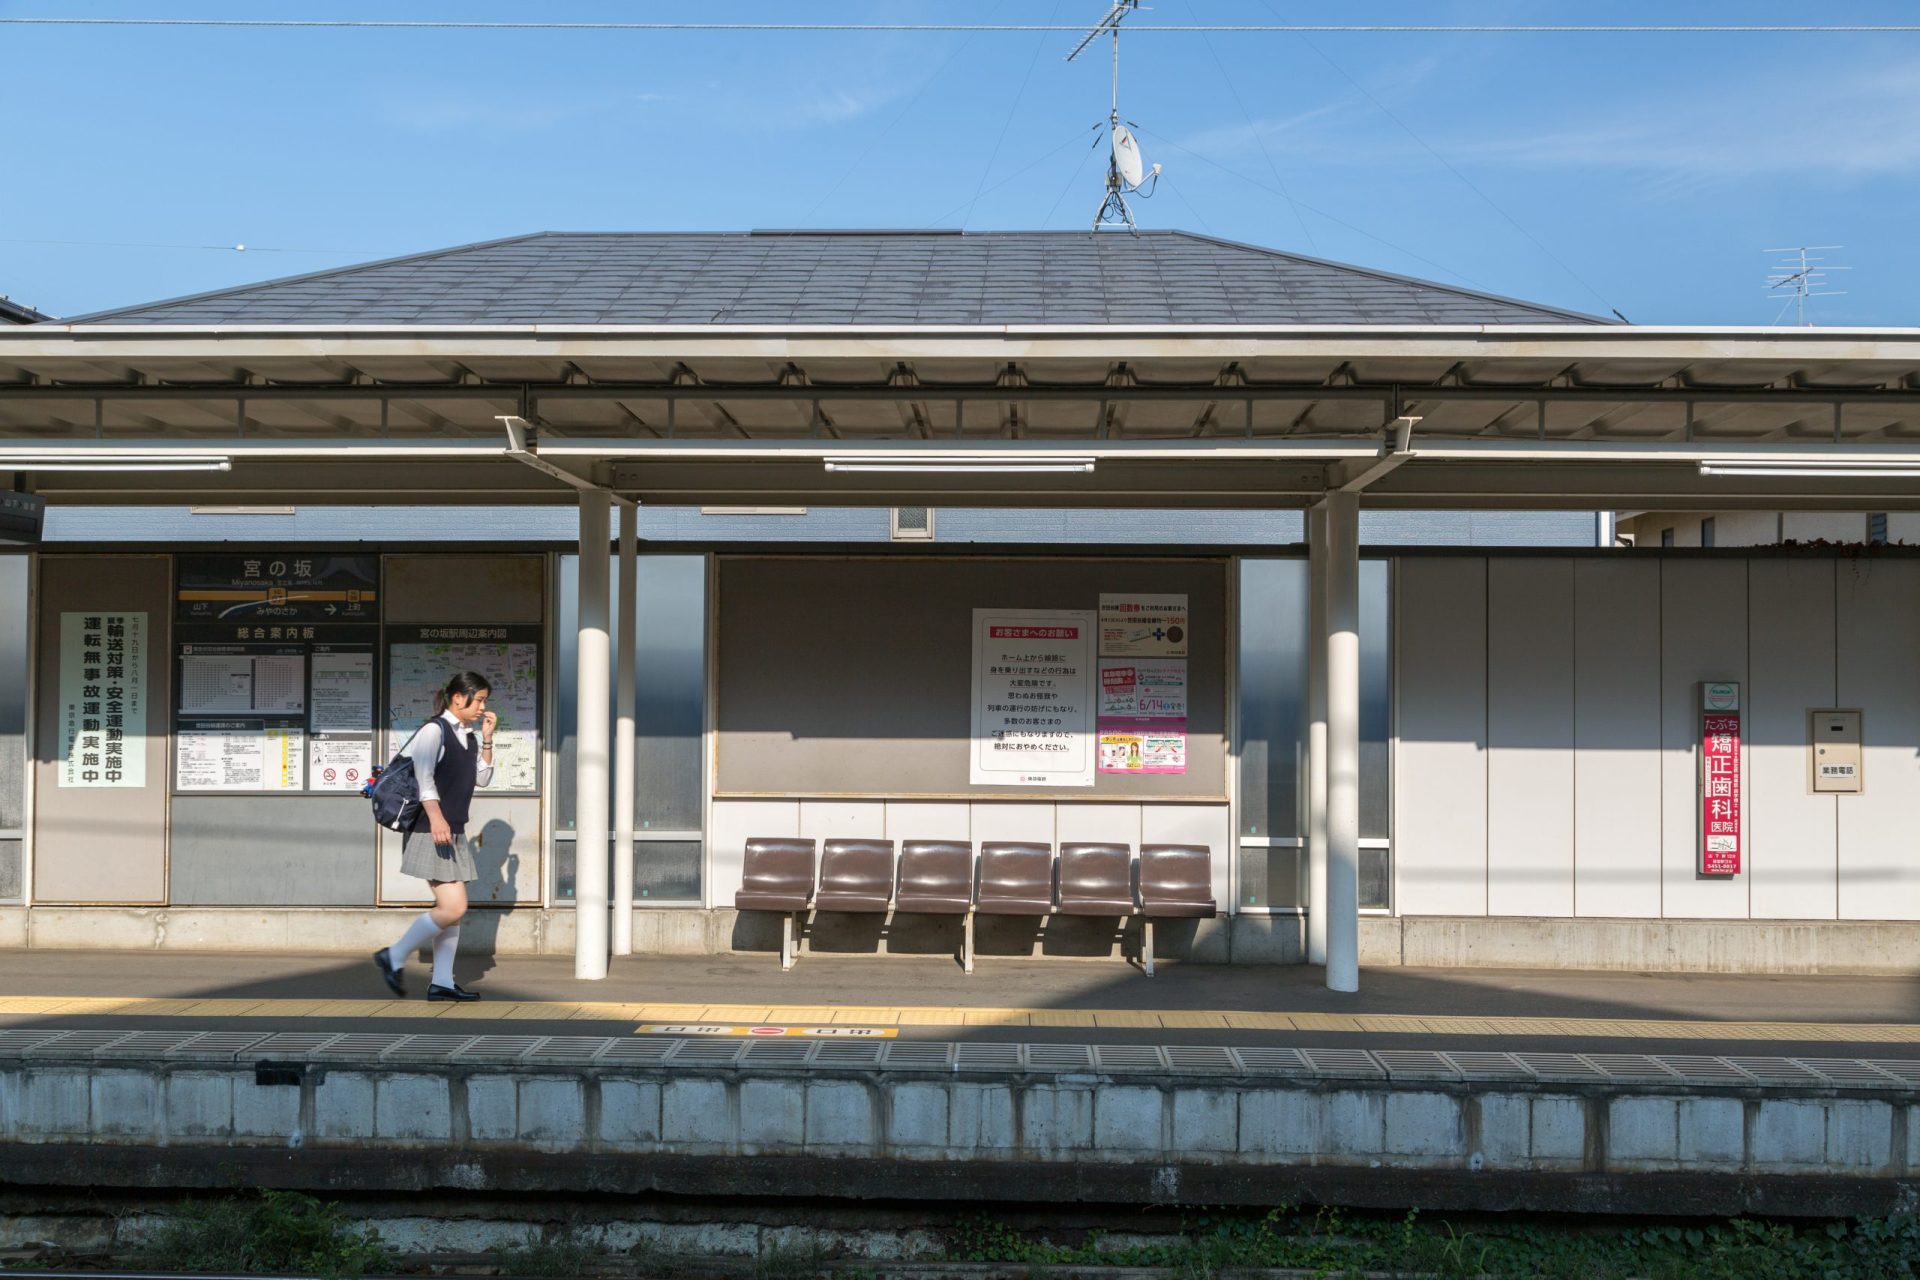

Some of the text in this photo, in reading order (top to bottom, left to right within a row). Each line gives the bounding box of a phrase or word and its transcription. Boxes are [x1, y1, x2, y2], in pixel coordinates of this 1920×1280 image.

[244, 560, 312, 577] 宮の坂
[231, 579, 273, 587] Miyanosaka
[256, 607, 298, 616] みやのさか
[346, 603, 361, 611] 上町
[237, 627, 315, 639] 総合案内板
[420, 628, 507, 638] 宮の坂駅周辺案内図
[995, 628, 1073, 637] お客さまへのお願い
[1001, 654, 1066, 662] ホーム上から線路に
[990, 666, 1076, 674] 身を乗り出すなどの行為は
[82, 617, 101, 783] 運転無事故運動実施中
[1008, 692, 1058, 700] 思わぬお怪我や
[1140, 699, 1163, 711] 6/14
[1004, 717, 1061, 725] 多数のお客さまの
[1705, 719, 1738, 730] たぶち
[991, 730, 1073, 738] ご迷惑にもなりますので、
[994, 742, 1070, 751] 絶対におやめください。
[1822, 766, 1854, 774] 業務電話
[1711, 733, 1733, 820] 矯正歯科
[1711, 821, 1734, 832] 医院
